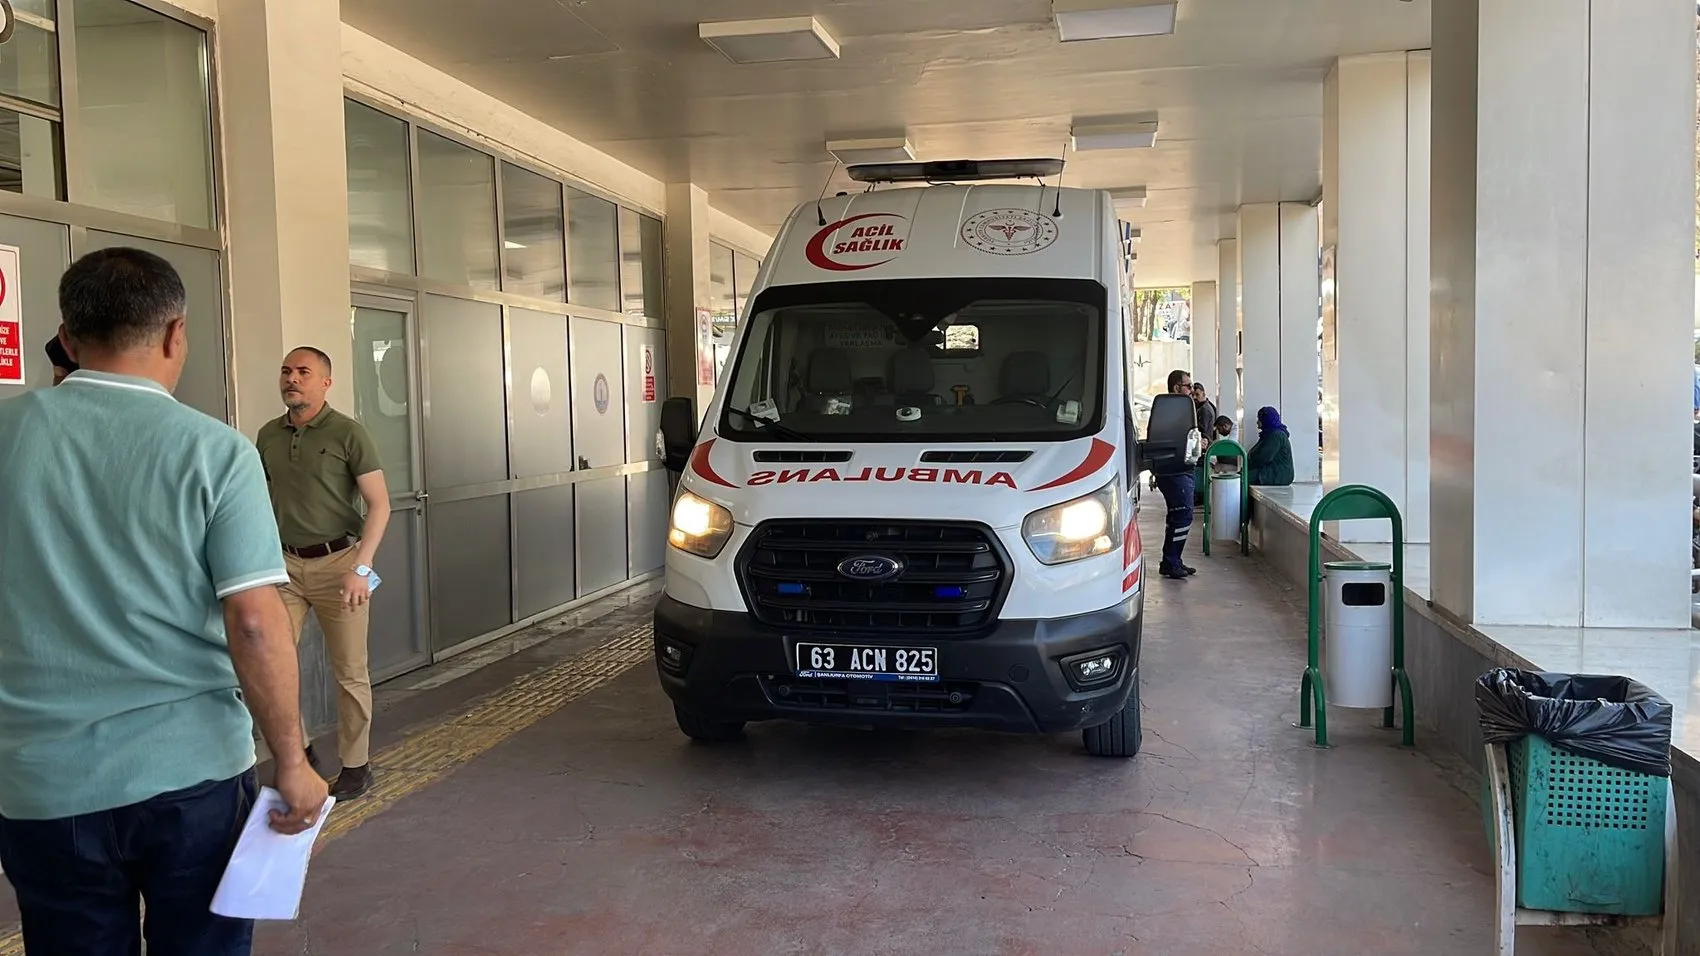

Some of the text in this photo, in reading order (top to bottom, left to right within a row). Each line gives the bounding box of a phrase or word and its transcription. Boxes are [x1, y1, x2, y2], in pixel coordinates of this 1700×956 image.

[851, 224, 894, 238] ACİL
[833, 237, 904, 254] SAĞLIK
[850, 560, 883, 575] Ford
[811, 647, 933, 672] 63 ACN 825
